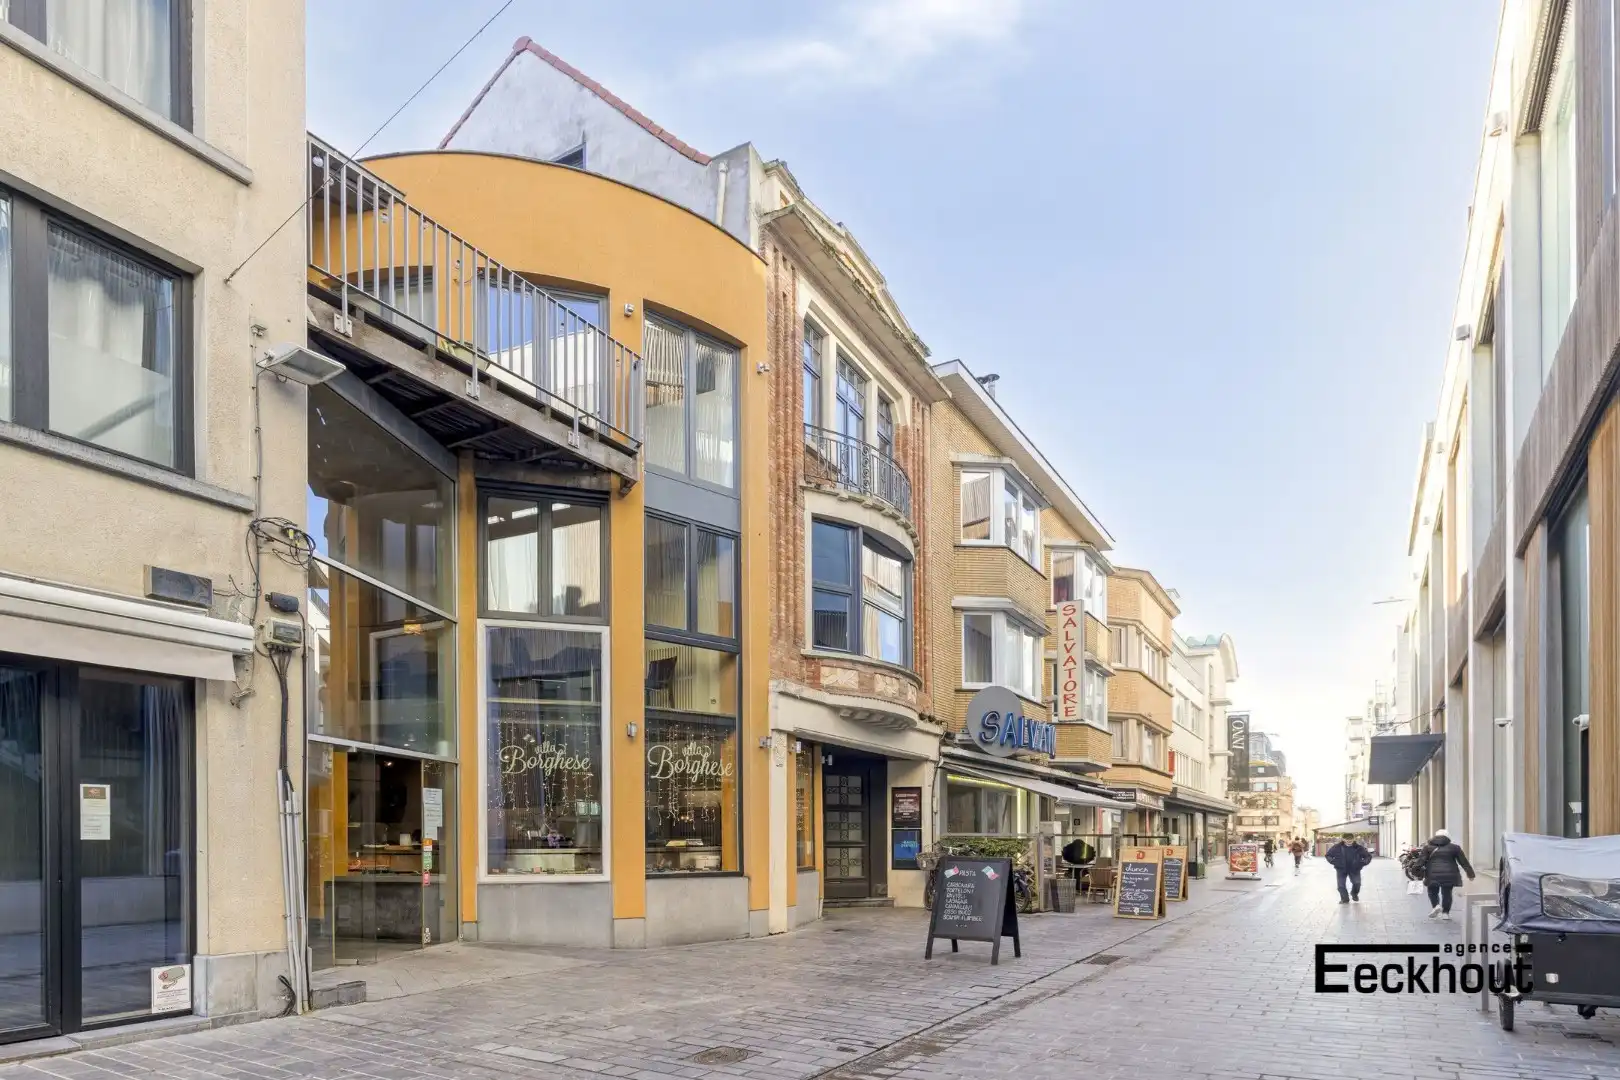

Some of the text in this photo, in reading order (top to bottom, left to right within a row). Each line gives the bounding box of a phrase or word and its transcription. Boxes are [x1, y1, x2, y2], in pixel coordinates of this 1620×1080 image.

[1063, 604, 1077, 717] SALVATORE
[535, 741, 560, 754] villa
[682, 741, 706, 756] villa
[1231, 720, 1244, 749] INNO
[499, 745, 591, 776] Borghese
[647, 745, 733, 782] Borghese
[959, 869, 976, 877] PASTA
